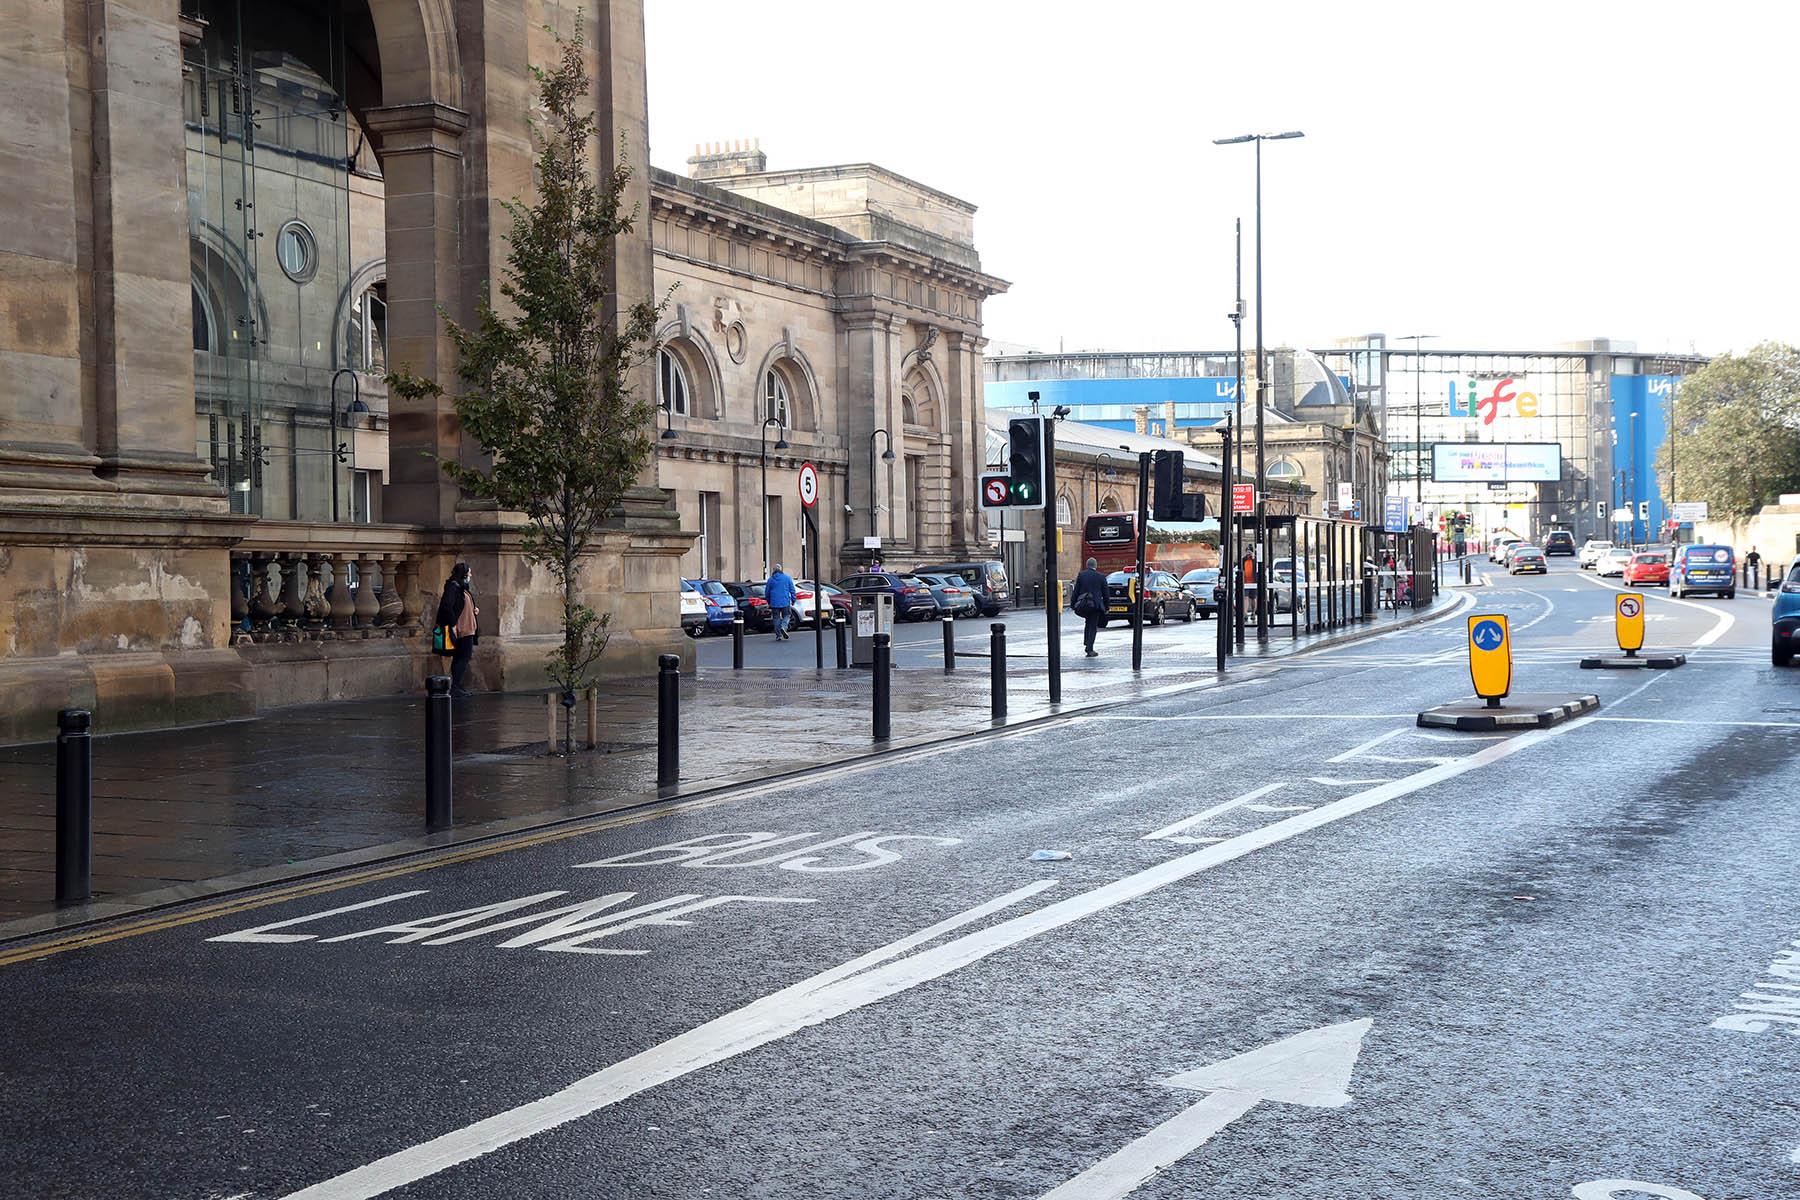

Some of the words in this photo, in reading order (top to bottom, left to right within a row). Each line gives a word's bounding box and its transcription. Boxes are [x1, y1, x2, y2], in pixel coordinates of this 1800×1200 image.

[1448, 378, 1538, 425] Life
[805, 476, 812, 495] 5
[571, 831, 964, 873] BUS
[204, 890, 820, 955] LANE
